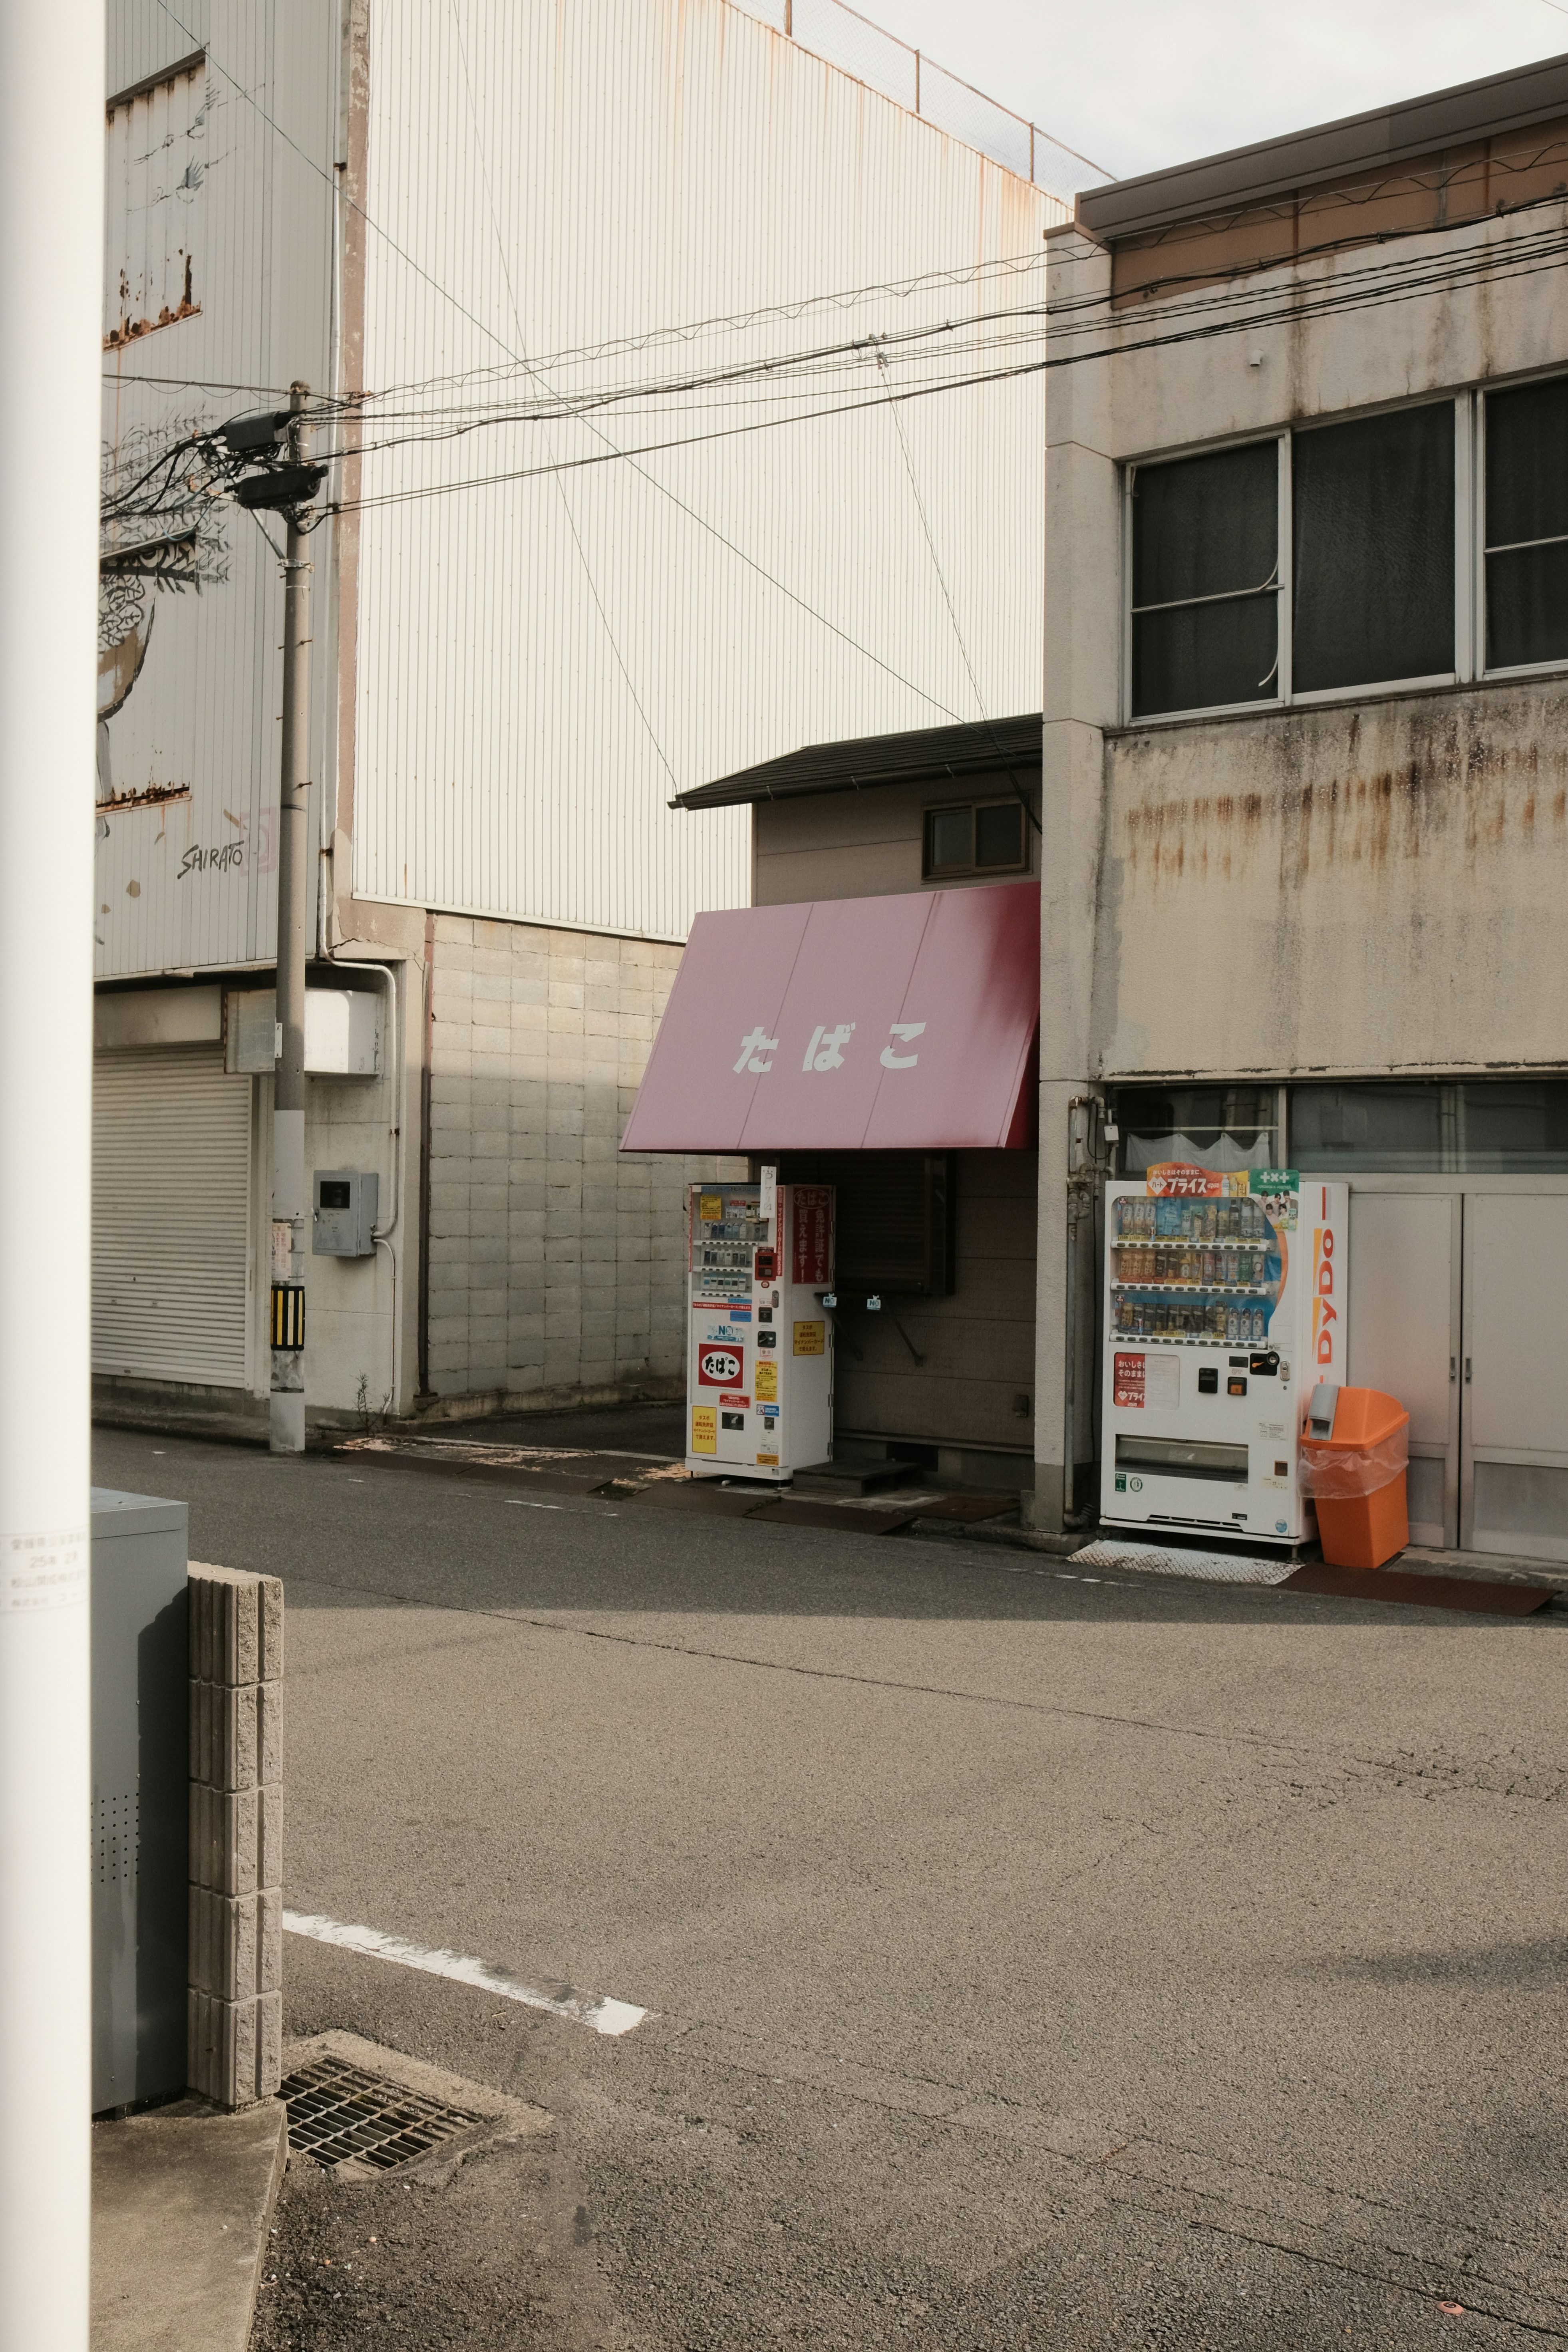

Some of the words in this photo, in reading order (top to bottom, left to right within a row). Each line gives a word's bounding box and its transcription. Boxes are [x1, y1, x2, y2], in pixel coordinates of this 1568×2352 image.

[177, 840, 244, 879] SHIRATO
[732, 1021, 926, 1074] たばこ
[1167, 1177, 1206, 1193] プライス
[815, 1210, 825, 1282] 免許証でも
[705, 1357, 735, 1375] たばこ
